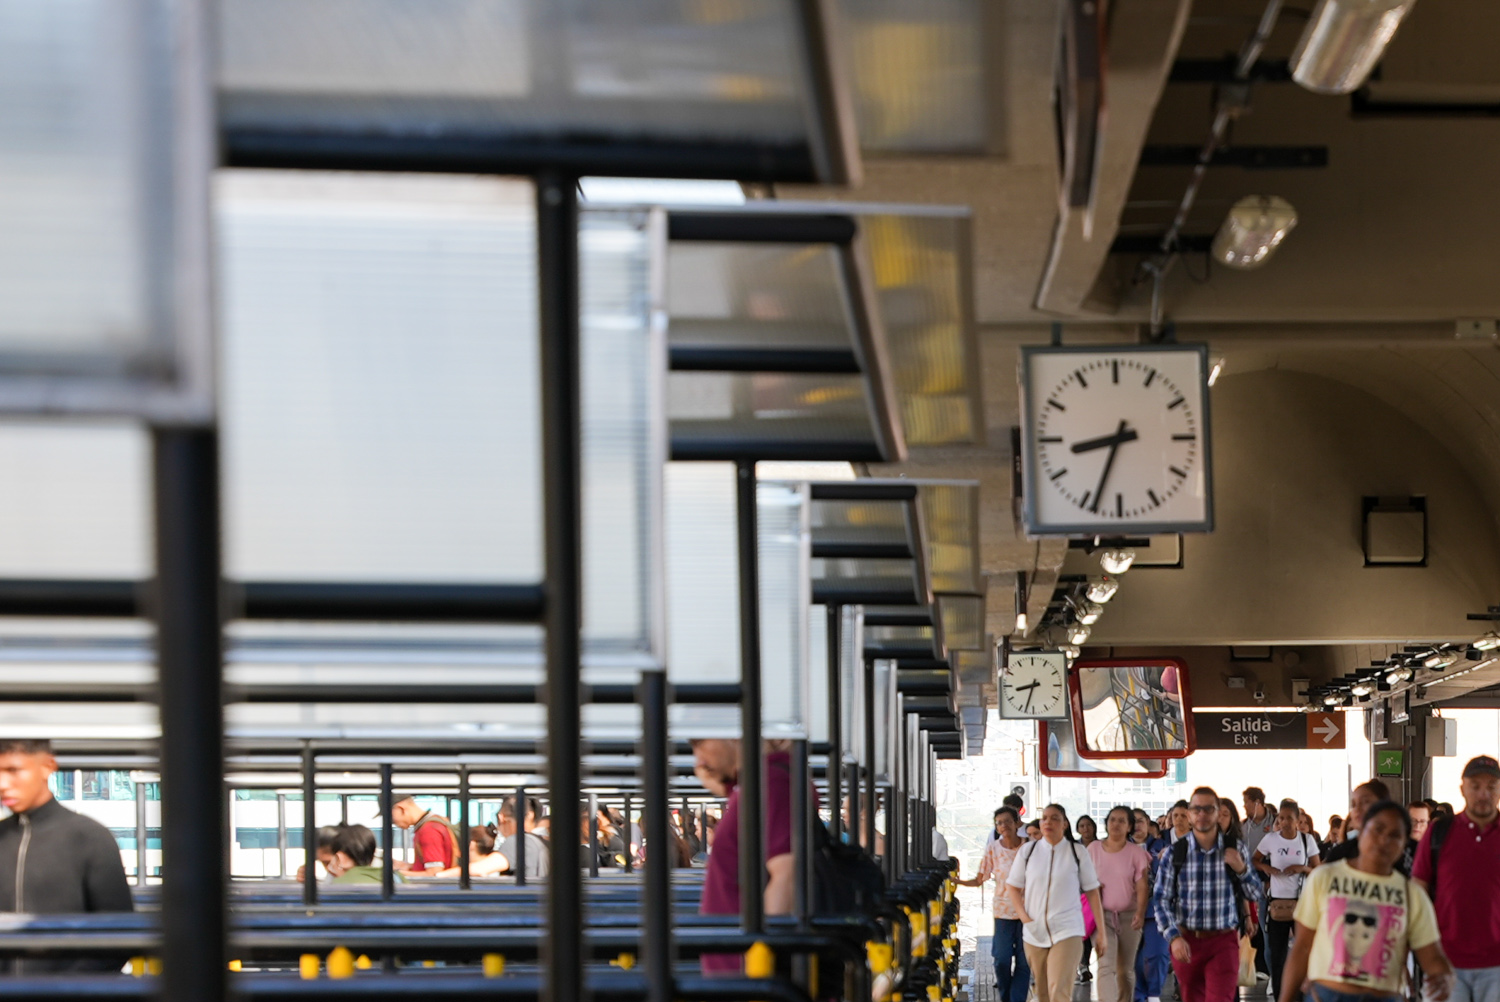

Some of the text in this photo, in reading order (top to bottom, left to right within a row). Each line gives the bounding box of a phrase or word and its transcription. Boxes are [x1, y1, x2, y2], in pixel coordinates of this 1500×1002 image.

[1221, 717, 1272, 732] Salida
[1234, 734, 1259, 745] Exit
[1328, 876, 1404, 905] ALWAYS
